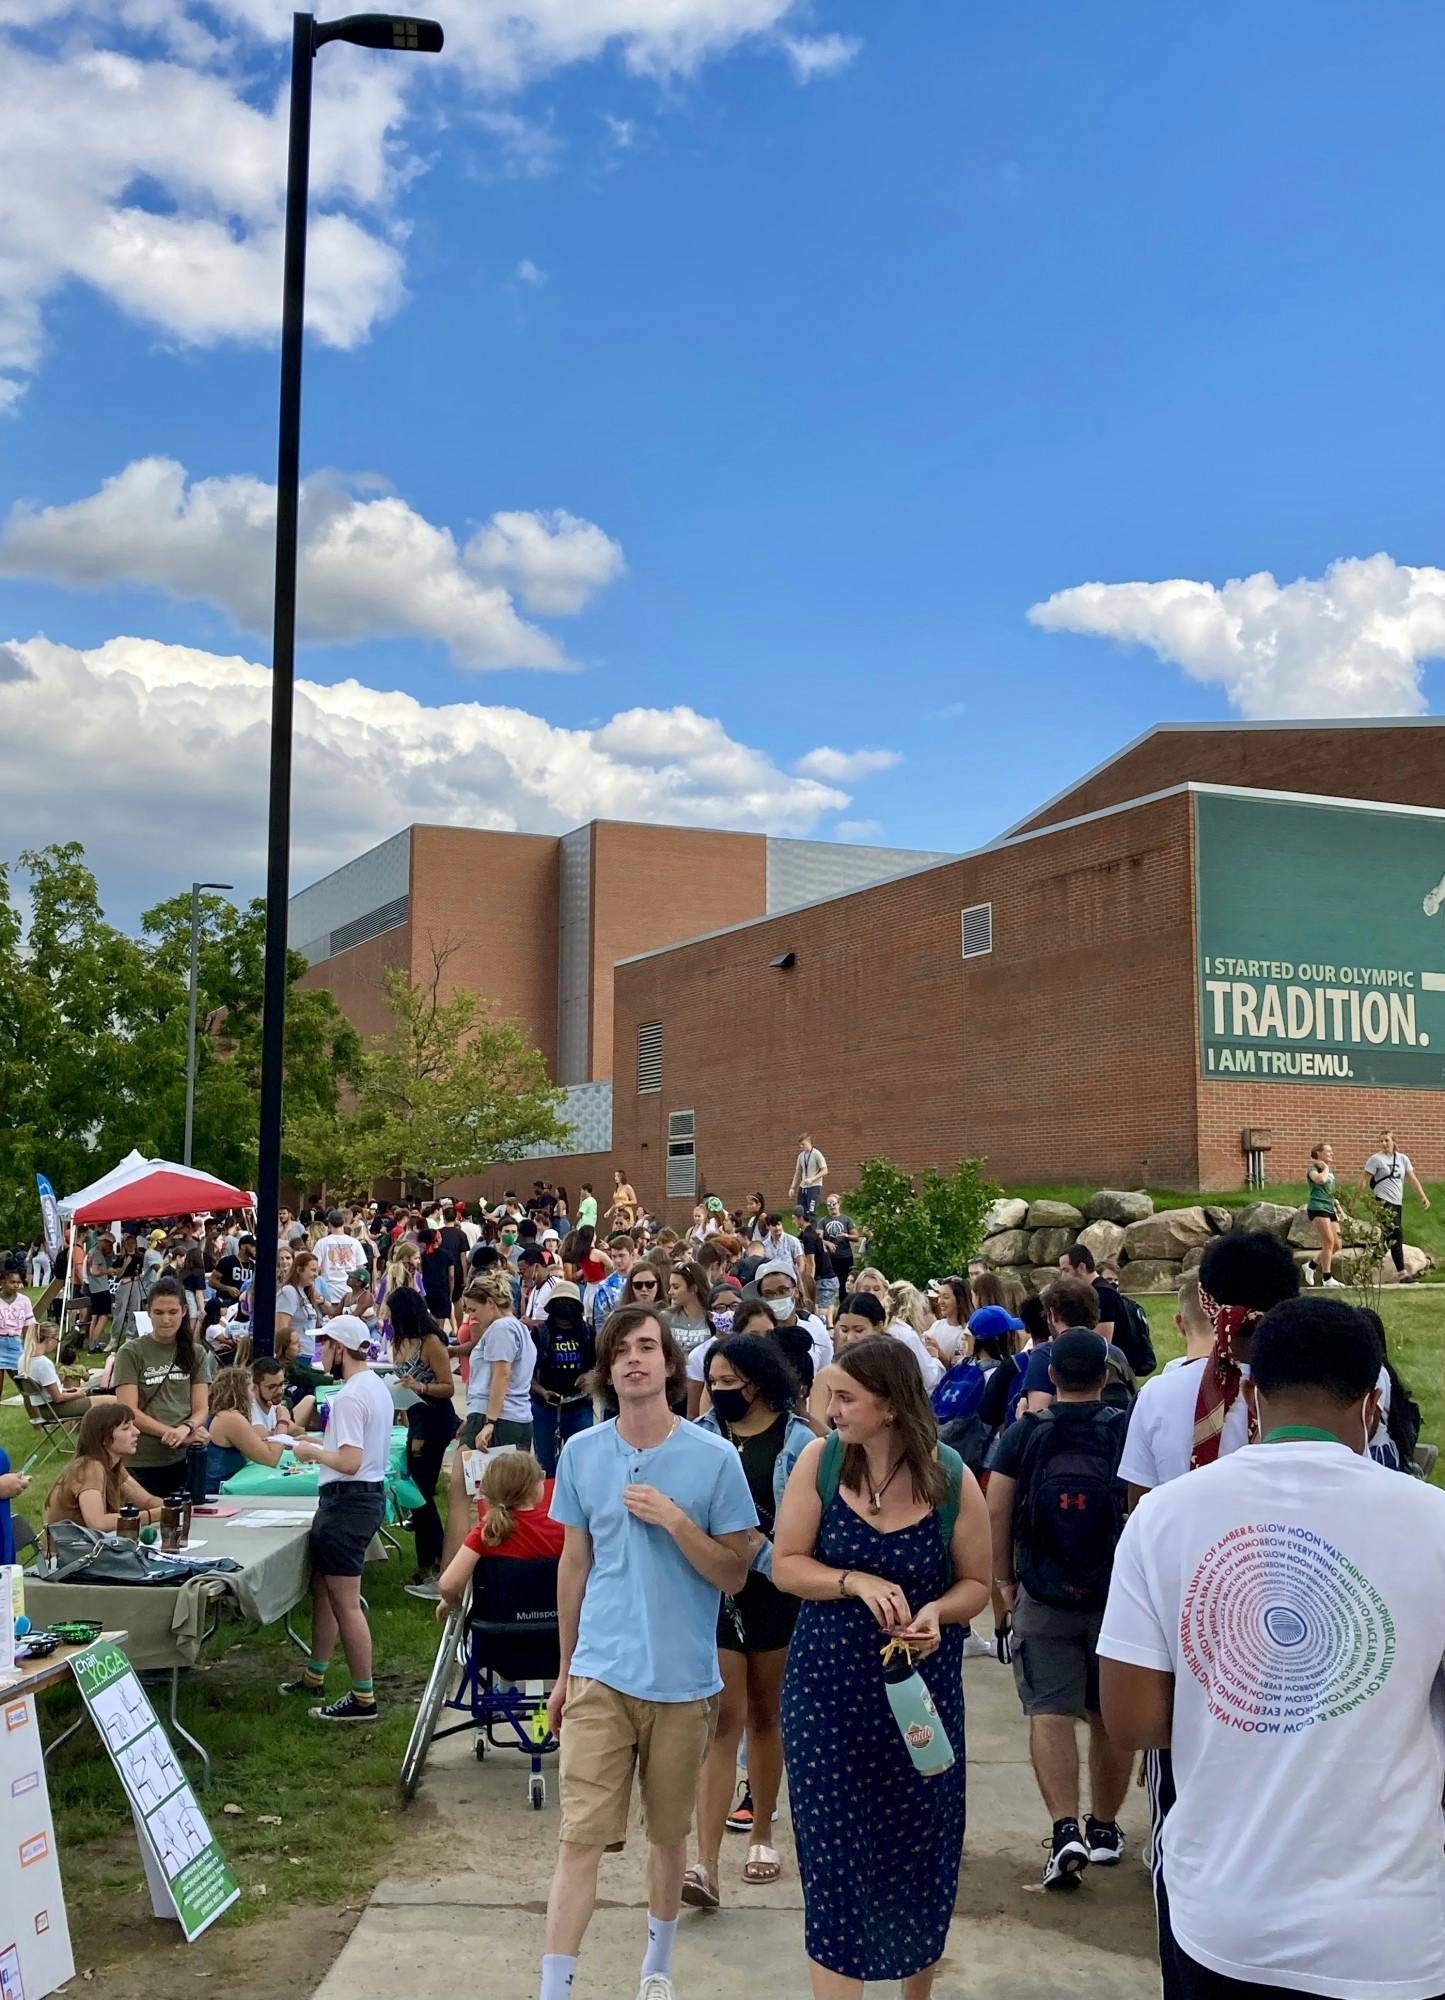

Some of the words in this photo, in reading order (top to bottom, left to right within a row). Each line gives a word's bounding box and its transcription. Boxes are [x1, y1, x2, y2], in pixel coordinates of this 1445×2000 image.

[1204, 957, 1210, 974] I
[1214, 958, 1294, 980] STARTED
[1298, 964, 1336, 983] OUR
[1340, 967, 1414, 988] OLYMPIC
[1206, 980, 1430, 1047] TRADITION.
[1207, 1048, 1214, 1071] I
[1219, 1049, 1256, 1073] AM
[1218, 1527, 1247, 1550] AMBER
[1248, 1526, 1255, 1534] &
[1256, 1524, 1286, 1532] GLOW
[1288, 1528, 1321, 1546] MOON
[1204, 1546, 1216, 1562] OF
[1232, 1538, 1286, 1553] TOMORROW
[1262, 1550, 1286, 1559] GLOW
[1216, 1550, 1232, 1570] NEW
[1234, 1552, 1256, 1568] AMBER
[1287, 1554, 1313, 1570] MOON
[1288, 1540, 1338, 1577] EVERYTHING
[1323, 1540, 1369, 1588] WATCHING
[1188, 1563, 1208, 1593] LUNE
[1224, 1565, 1234, 1576] OF
[1200, 1568, 1218, 1598] BRAVE
[1313, 1566, 1348, 1602] WATCHING
[1336, 1572, 1358, 1596] FALLS
[1354, 1594, 1370, 1618] INTO
[1366, 1586, 1382, 1605] THE
[516, 1610, 558, 1620] Multispo
[1180, 1595, 1196, 1658] SPHERICAL
[1196, 1609, 1206, 1640] PLACE
[1366, 1617, 1378, 1644] PLACE
[1376, 1604, 1396, 1654] SPHERICAL
[75, 1653, 98, 1674] Chair
[88, 1650, 126, 1686] YOGA
[1187, 1654, 1202, 1676] THE
[1358, 1652, 1376, 1678] BRAVE
[1375, 1657, 1394, 1682] LUNE
[1248, 1689, 1282, 1701] MOON
[1342, 1676, 1364, 1694] NEW
[1364, 1682, 1380, 1696] OF
[1216, 1684, 1280, 1716] EVERYTHING
[1328, 1692, 1367, 1718] AMBER
[1232, 1717, 1281, 1733] MOON
[1316, 1712, 1327, 1722] &
